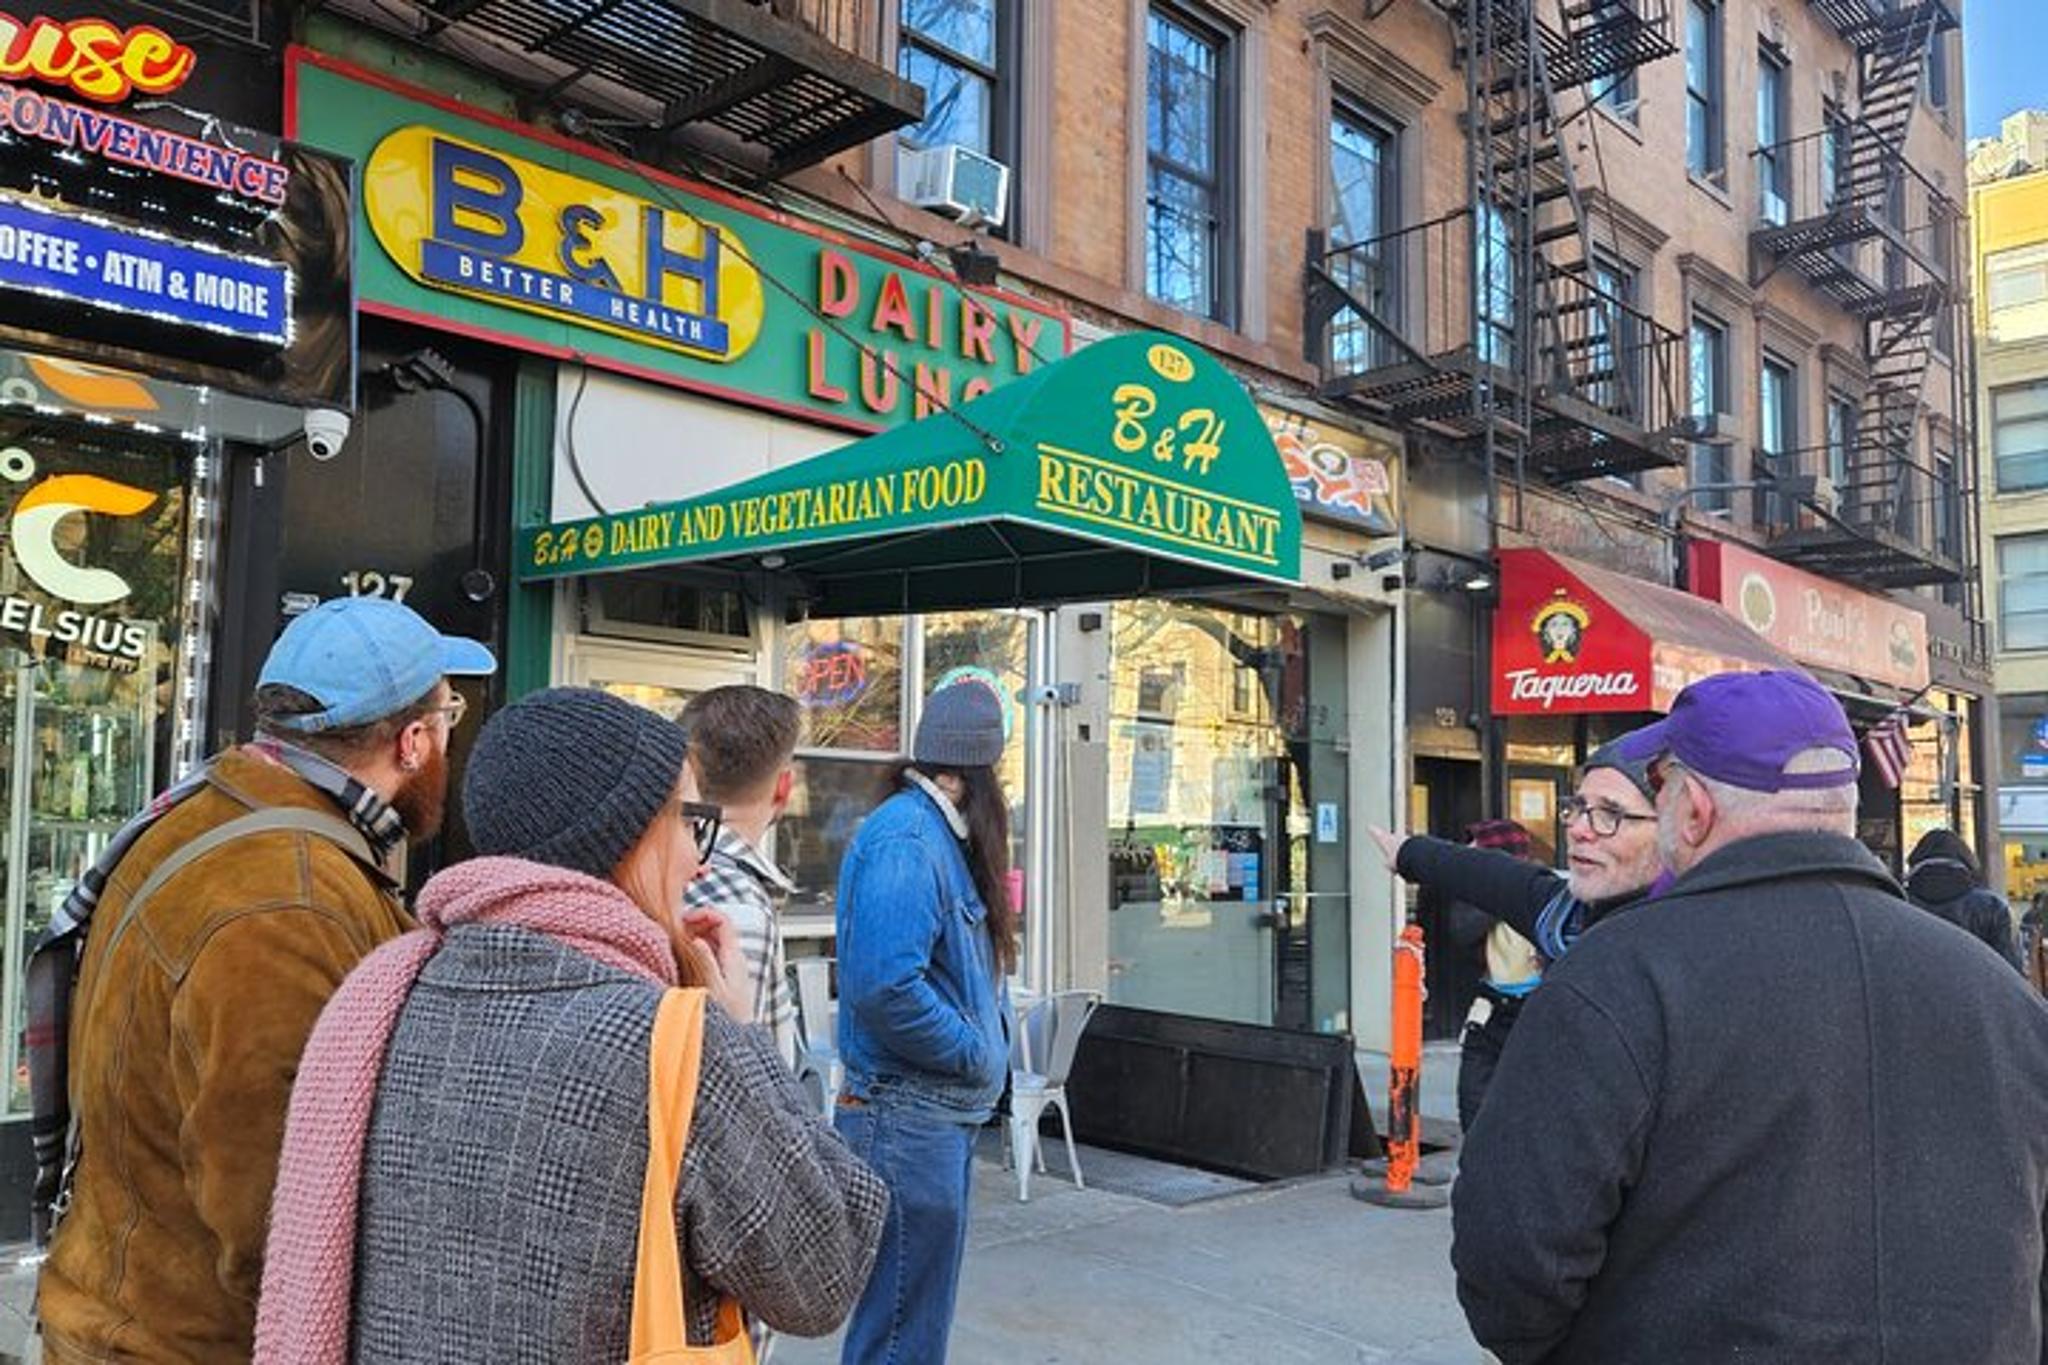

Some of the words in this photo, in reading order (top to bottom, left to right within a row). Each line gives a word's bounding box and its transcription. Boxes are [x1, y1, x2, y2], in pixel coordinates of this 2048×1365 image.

[431, 137, 524, 257] B
[642, 205, 720, 318] H
[103, 249, 164, 295] ATM
[168, 269, 189, 300] &
[193, 271, 269, 318] MORE
[459, 255, 575, 307] BETTER
[610, 297, 703, 341] HEALTH
[820, 249, 1041, 375] DAIRY
[807, 328, 993, 421] LUN
[611, 509, 673, 556] DAIRY
[679, 504, 726, 546] AND
[730, 474, 898, 537] VEGETARIAN
[902, 457, 987, 513] FOOD
[1038, 453, 1281, 557] RESTAURANT
[0, 597, 146, 657] ELSIUS
[341, 570, 414, 604] 127
[1504, 668, 1639, 709] Taqueria
